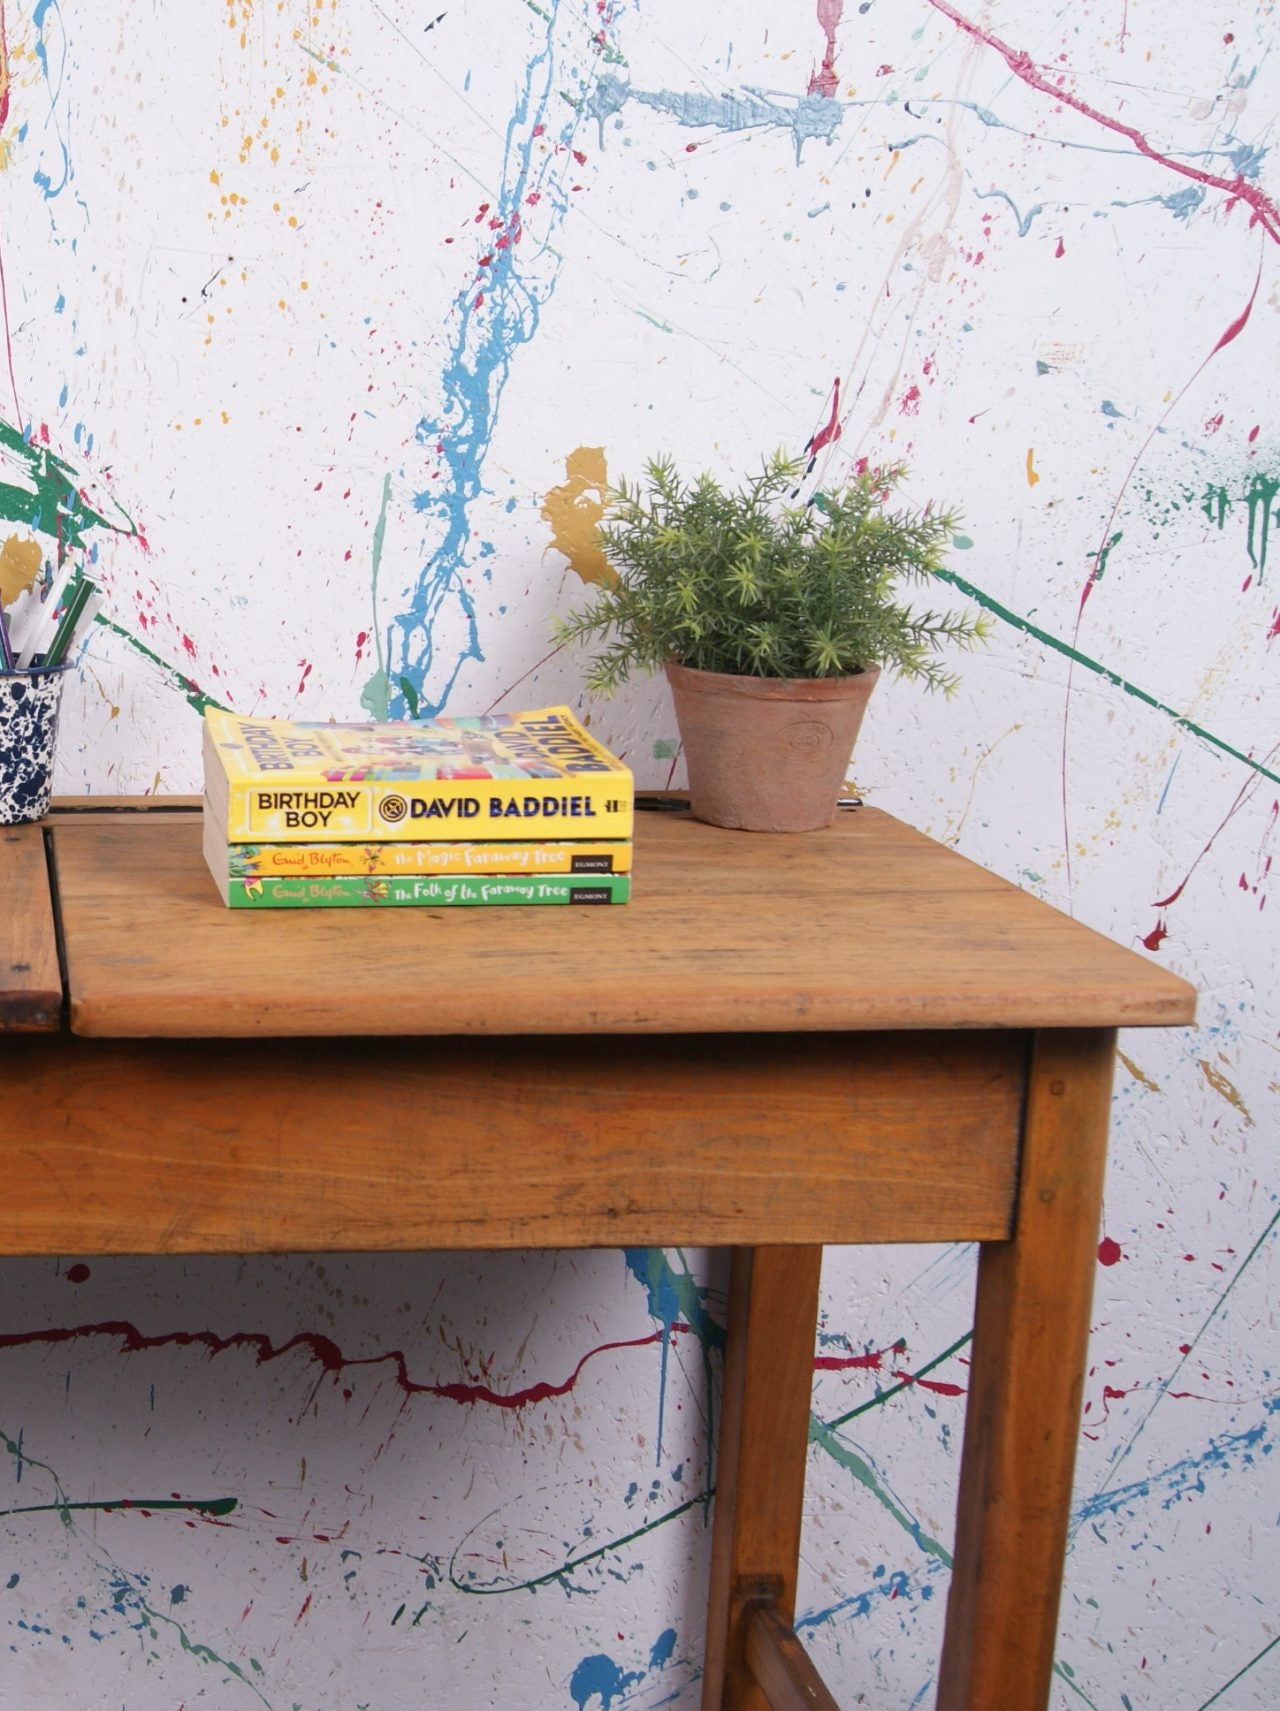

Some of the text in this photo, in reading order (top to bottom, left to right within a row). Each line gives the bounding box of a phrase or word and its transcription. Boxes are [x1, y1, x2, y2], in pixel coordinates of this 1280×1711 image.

[238, 722, 294, 770] BIRTHDAY
[282, 736, 324, 757] BOY
[495, 731, 549, 758] DAVID
[520, 715, 611, 771] BADDIEL
[258, 792, 361, 809] BIRTHDAY
[410, 798, 480, 818] DAVID
[489, 796, 596, 817] BADDIEL
[285, 811, 332, 827] BOY
[272, 852, 352, 867] Enid Blyton
[416, 849, 462, 867] Magic
[464, 848, 529, 867] Faraway
[534, 850, 566, 865] Tree
[272, 884, 352, 900] Enid Blyton
[395, 883, 568, 902] The Folk of the Faraway Tree
